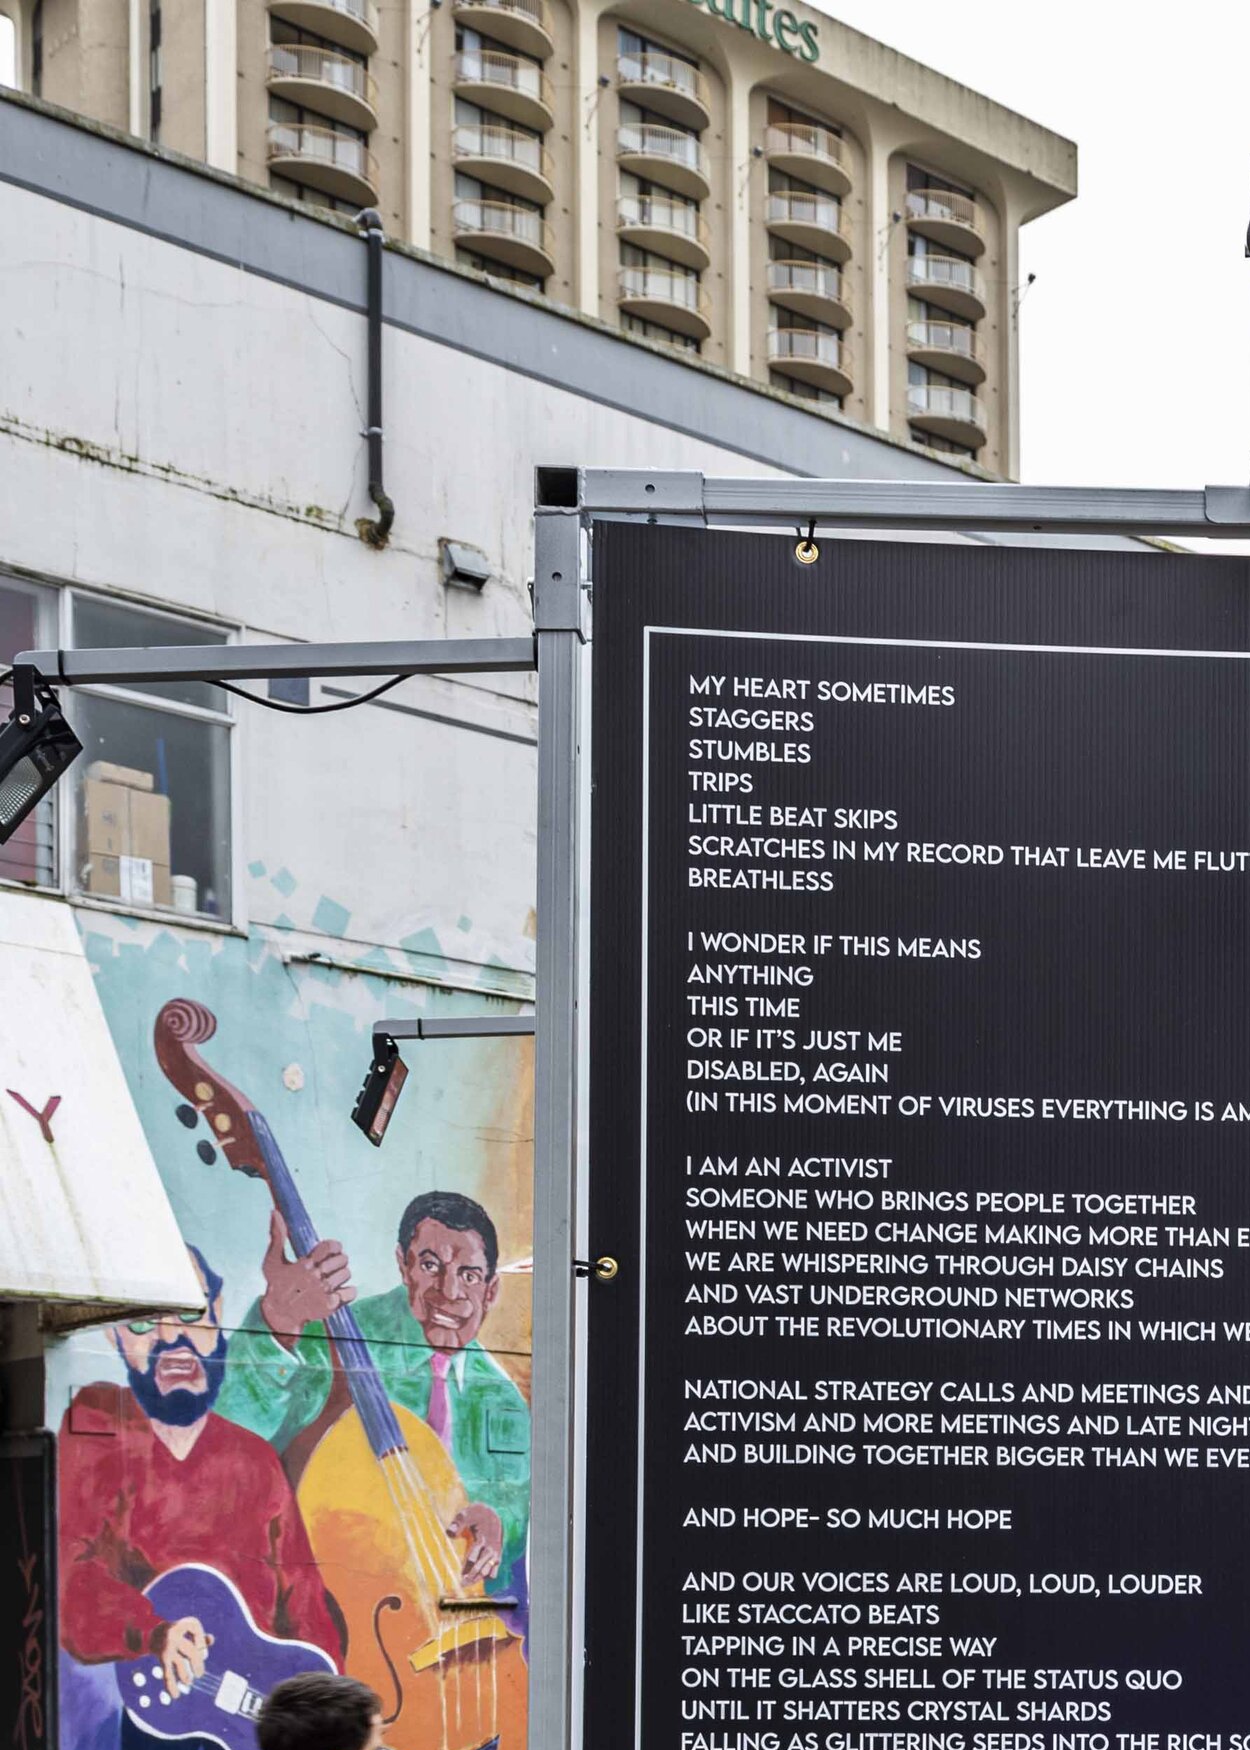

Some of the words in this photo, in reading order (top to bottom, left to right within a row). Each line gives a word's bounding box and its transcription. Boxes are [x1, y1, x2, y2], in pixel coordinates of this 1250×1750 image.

[690, 675, 726, 695] MY
[734, 677, 811, 699] HEART
[818, 681, 955, 706] SOMETIMES
[689, 739, 811, 763] STUMBLES
[689, 803, 762, 825] LITTLE
[770, 806, 827, 827] BEAT
[834, 808, 897, 830] SKIPS
[689, 868, 833, 891] BREATHLESS
[687, 964, 813, 986] ANYTHING
[687, 1028, 722, 1047] OR
[731, 1029, 749, 1048] IF
[757, 1029, 795, 1049] IT'S
[803, 1031, 861, 1050] JUST
[868, 1032, 902, 1051] ME
[5, 1088, 62, 1144] Y
[687, 1091, 717, 1112] (IN
[725, 1093, 776, 1112] THIS
[784, 1094, 892, 1114] MOMENT
[899, 1096, 932, 1115] OF
[939, 1097, 1034, 1118] VIRUSES
[1042, 1099, 1187, 1120] EVERYTHING
[1195, 1101, 1214, 1121] IS
[686, 1188, 807, 1209] SOMEONE
[815, 1190, 873, 1210] WHO
[882, 1191, 968, 1211] BRINGS
[977, 1192, 1065, 1213] PEOPLE
[1072, 1194, 1196, 1215] TOGETHER
[685, 1252, 720, 1271] WE
[728, 1252, 774, 1272] ARE
[782, 1253, 928, 1274] WHISPERING
[935, 1255, 1053, 1276] THROUGH
[1062, 1257, 1128, 1277] DAISY
[1135, 1258, 1224, 1278] CHAINS
[685, 1316, 768, 1336] ABOUT
[775, 1317, 819, 1336] THE
[828, 1317, 1026, 1339] REVOLUTIONARY
[1032, 1320, 1101, 1340] TIMES
[1109, 1321, 1131, 1340] IN
[1138, 1321, 1215, 1341] WHICH
[684, 1412, 795, 1432] ACTIVISM
[803, 1413, 856, 1432] AND
[864, 1413, 933, 1433] MORE
[941, 1414, 1060, 1434] MEETINGS
[1067, 1415, 1119, 1435] AND
[1127, 1416, 1181, 1435] LATE
[683, 1508, 735, 1527] AND
[744, 1508, 819, 1527] HOPE-
[827, 1508, 861, 1528] SO
[869, 1509, 939, 1528] MUCH
[948, 1510, 1012, 1529] HOPE
[683, 1604, 730, 1623] LIKE
[738, 1604, 861, 1624] STACCATO
[869, 1605, 939, 1624] BEATS
[682, 1668, 719, 1687] ON
[727, 1668, 771, 1687] THE
[779, 1668, 857, 1688] GLASS
[864, 1669, 935, 1688] SHELL
[942, 1669, 976, 1688] OF
[982, 1669, 1026, 1689] THE
[1034, 1669, 1118, 1689] STATUS
[1125, 1670, 1182, 1690] QUO
